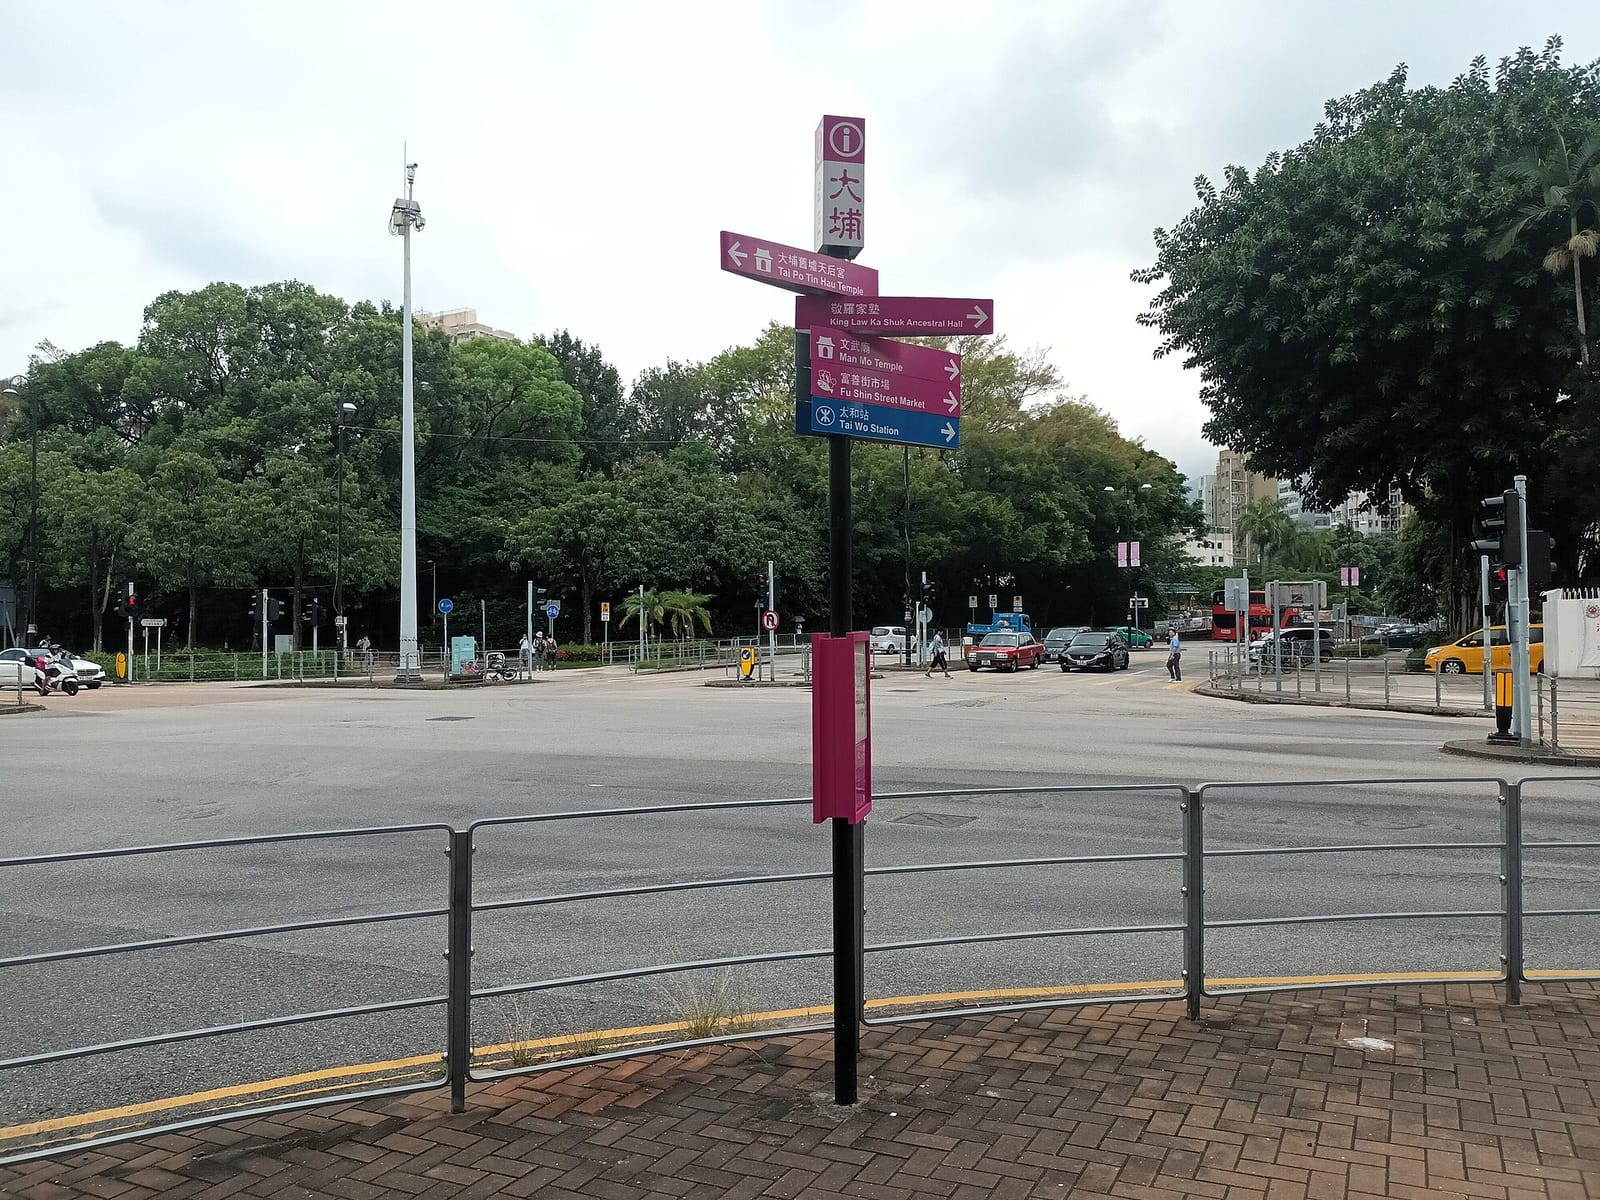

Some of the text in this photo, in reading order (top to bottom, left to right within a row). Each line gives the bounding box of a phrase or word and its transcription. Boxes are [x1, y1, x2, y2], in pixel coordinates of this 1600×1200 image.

[829, 168, 862, 241] 大埔
[778, 266, 864, 296] Tai Po Tin Hau Temple
[831, 303, 880, 315] 敬羅家塾
[830, 318, 963, 328] King Law Ka Shuk Ancestral Hall
[840, 338, 870, 354] 文武廟
[839, 352, 903, 372] Man Mo Temple
[840, 372, 890, 391] 富善街市場
[840, 387, 925, 409] Fu Shin Street Market
[839, 406, 869, 421] 太和站
[839, 420, 899, 436] Tai Wo Station
